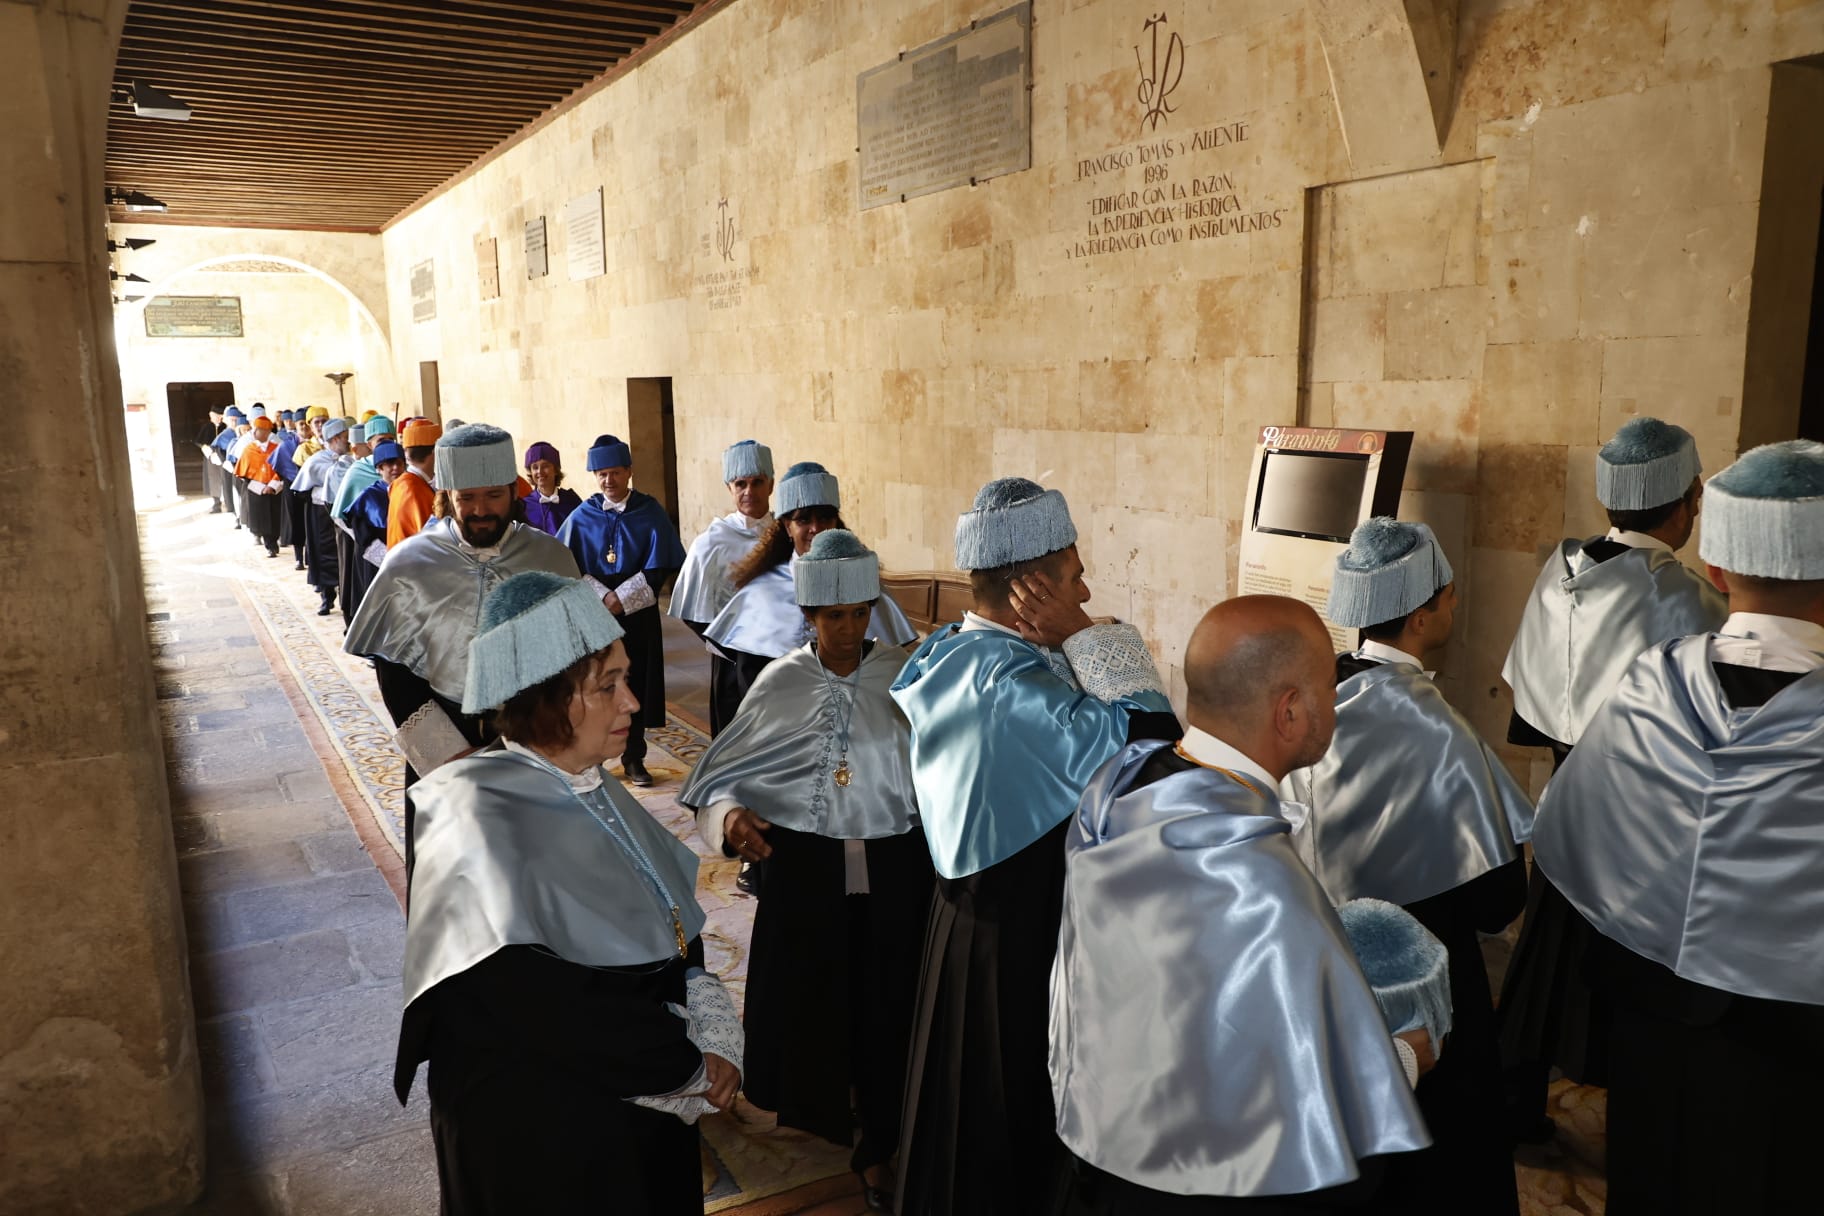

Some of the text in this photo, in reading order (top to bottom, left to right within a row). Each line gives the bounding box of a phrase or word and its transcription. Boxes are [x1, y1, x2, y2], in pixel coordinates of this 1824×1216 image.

[1078, 151, 1134, 179] FRANCISCO
[1144, 163, 1169, 185] 1996
[1142, 187, 1166, 205] CON
[1172, 183, 1187, 201] LA
[1088, 220, 1099, 237] LA
[1179, 194, 1243, 221] HISTORICA
[1075, 241, 1087, 259] LA
[1087, 232, 1147, 257] TOLERANCIA
[1150, 225, 1184, 246] COMO
[1263, 426, 1342, 450] Paraninfo
